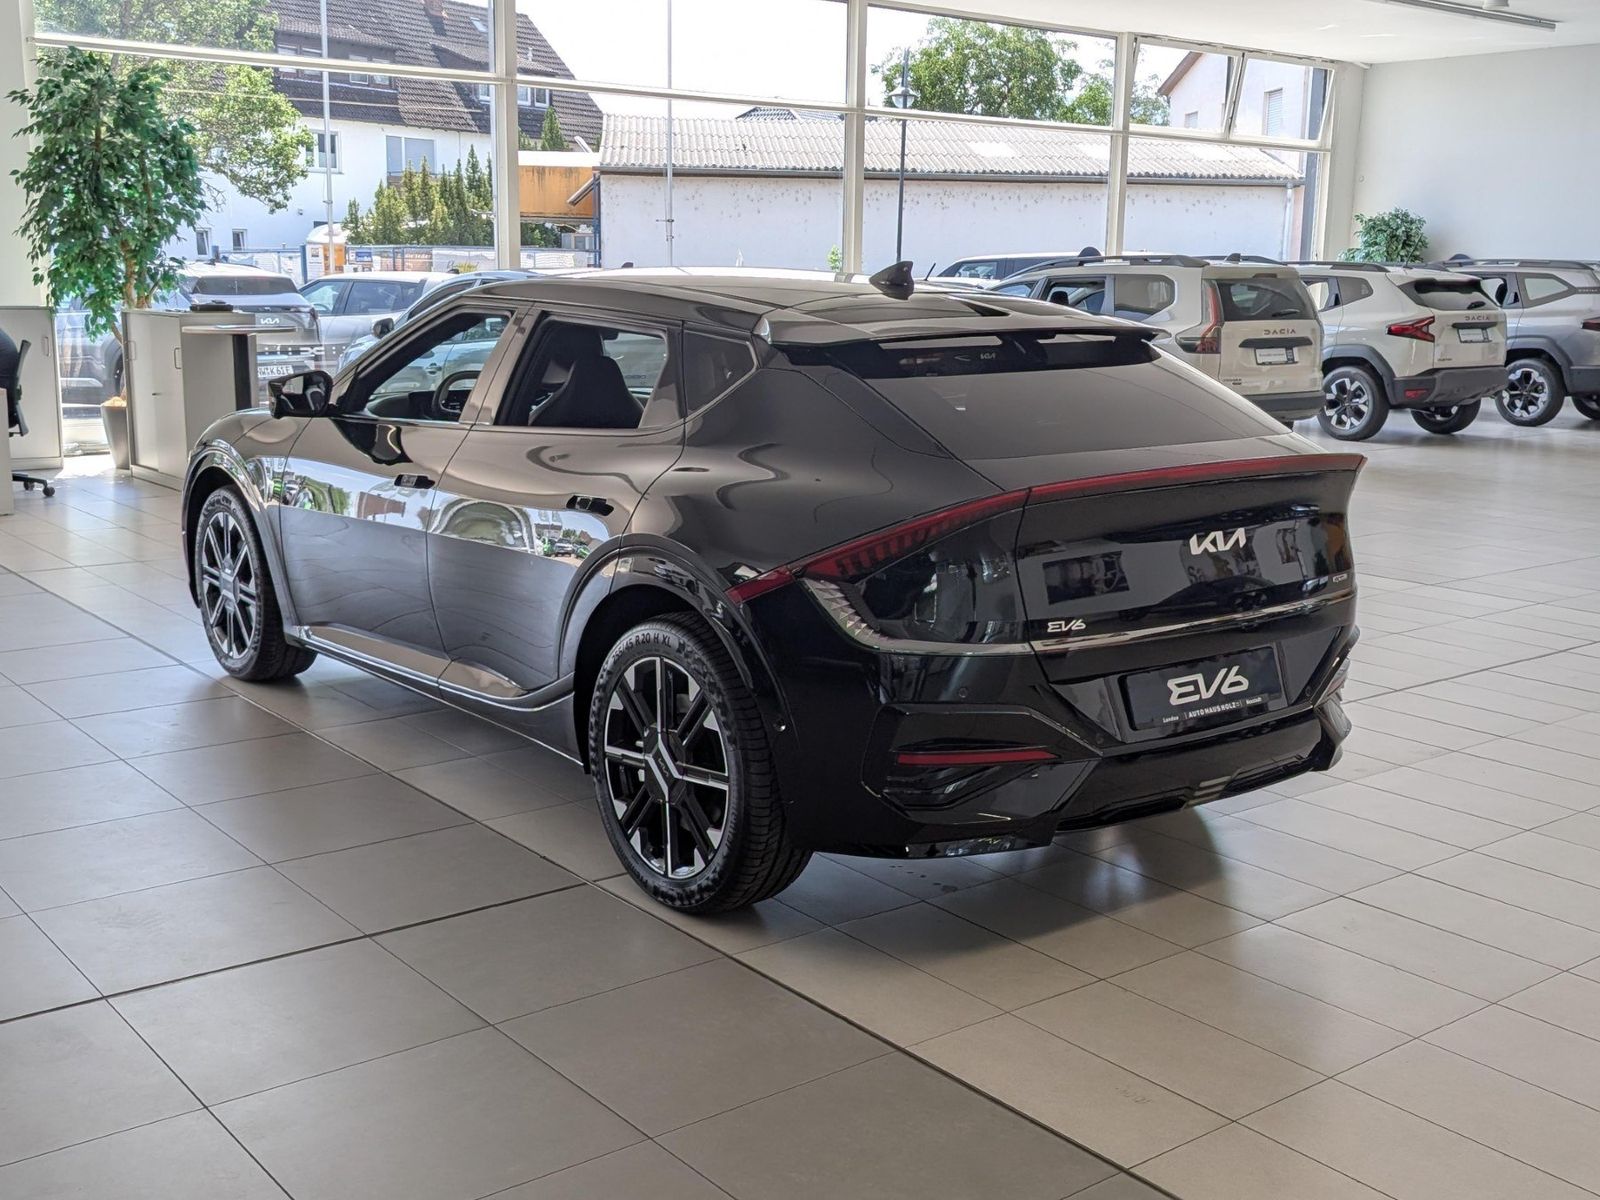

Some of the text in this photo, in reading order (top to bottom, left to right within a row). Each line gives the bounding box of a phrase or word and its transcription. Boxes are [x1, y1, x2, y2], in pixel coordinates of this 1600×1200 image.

[1189, 527, 1247, 556] KIA
[1047, 619, 1087, 632] EV6
[653, 633, 660, 644] H
[662, 634, 672, 648] XL
[1167, 665, 1249, 706] EV6
